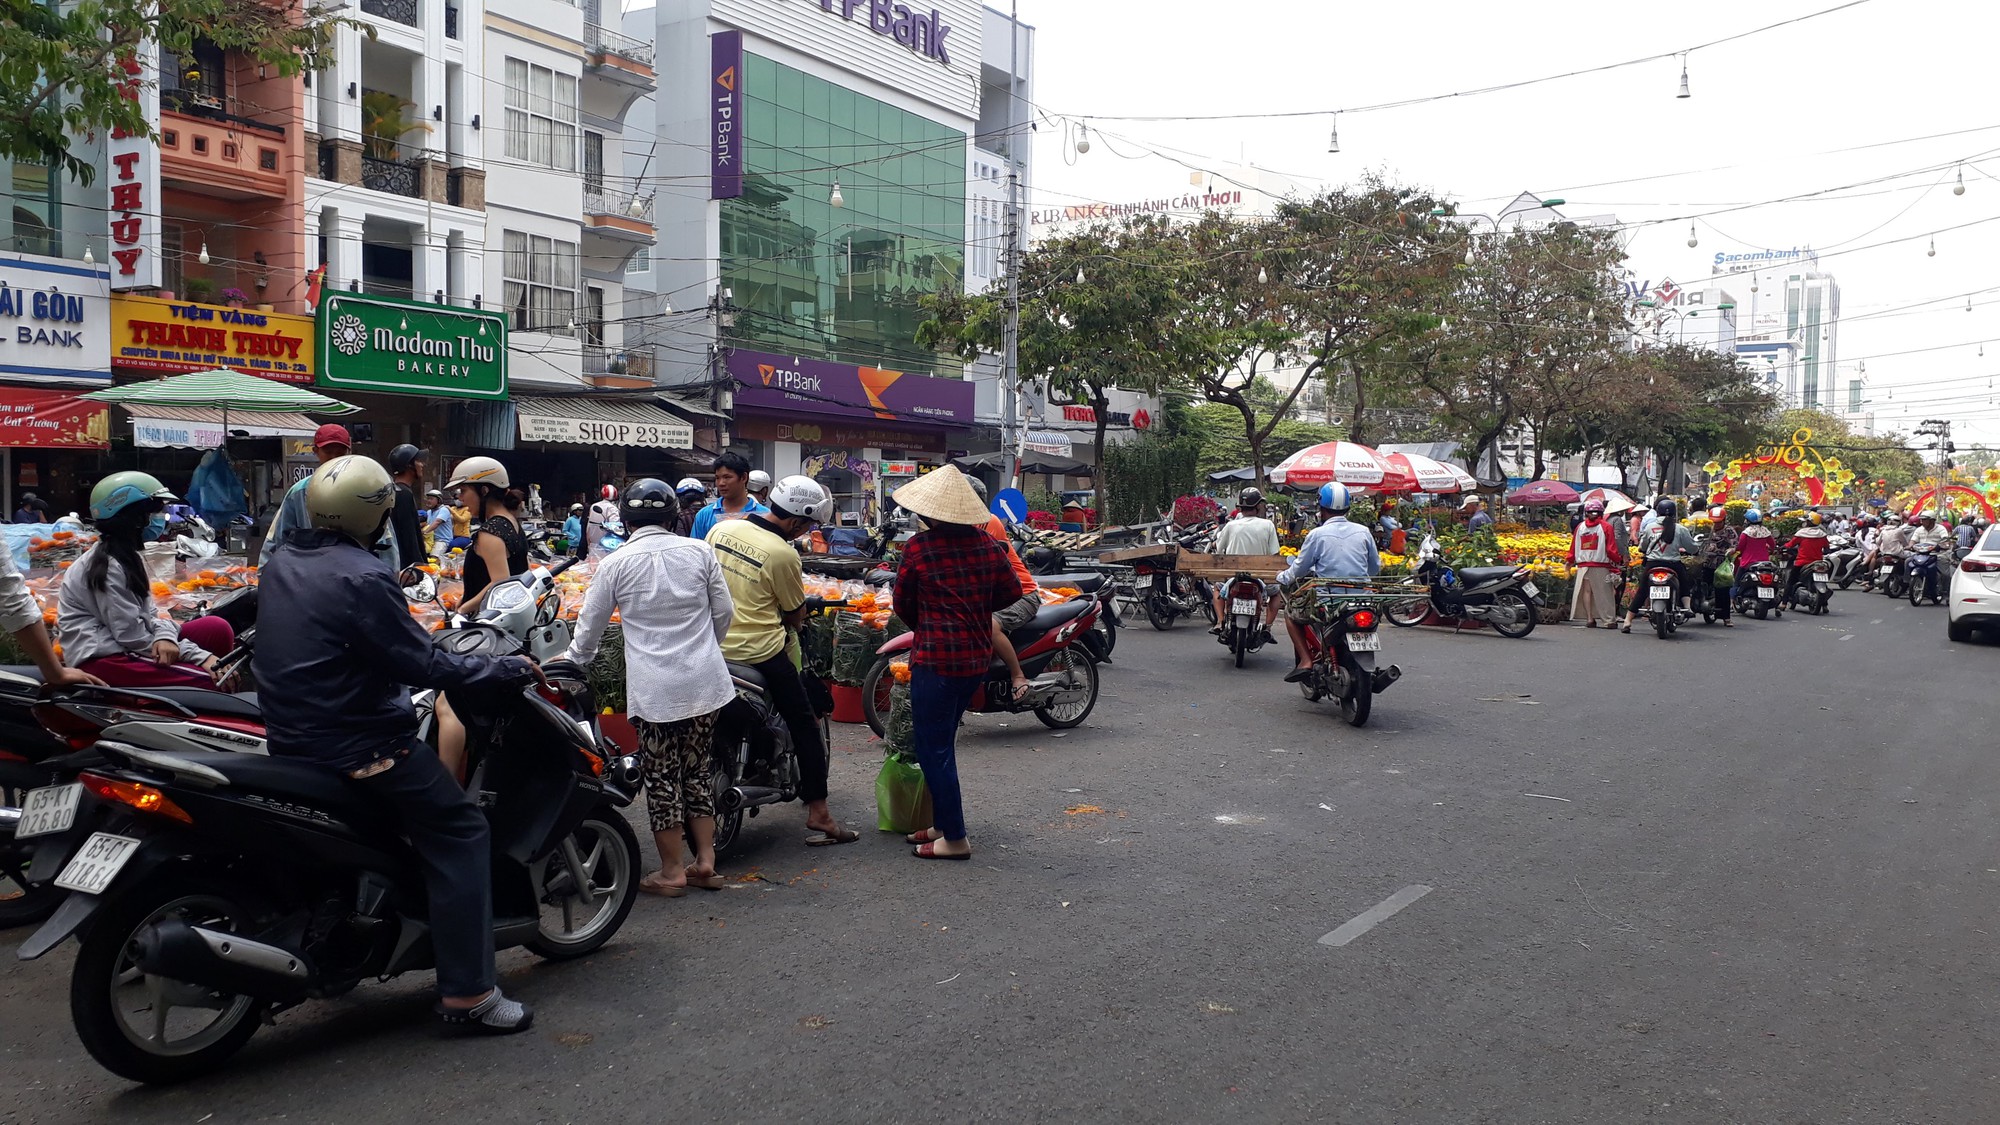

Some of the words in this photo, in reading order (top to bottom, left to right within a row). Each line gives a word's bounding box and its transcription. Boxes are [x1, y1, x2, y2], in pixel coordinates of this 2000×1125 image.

[718, 92, 732, 167] TPBank
[111, 152, 142, 275] THÚY
[1124, 199, 1168, 215] NHÁNH
[1172, 193, 1199, 209] CẦN
[1202, 191, 1230, 206] THƠ
[1233, 191, 1241, 204] II
[1714, 246, 1800, 265] Sacombank
[170, 305, 214, 322] TIỆM
[220, 309, 267, 327] VÀNG
[17, 326, 83, 348] BANK
[128, 319, 227, 352] THANH
[232, 330, 303, 360] THÚY
[374, 327, 453, 358] Madam
[456, 335, 494, 362] Thu
[121, 346, 158, 359] CHUYÊN
[160, 350, 181, 361] MUA
[183, 352, 201, 363] BÁN
[250, 357, 271, 370] VÀNG
[397, 359, 470, 377] BAKERY
[776, 369, 822, 392] TPBank
[163, 427, 189, 445] VÀNG
[579, 422, 630, 444] SHOP
[636, 425, 659, 444] 23
[1339, 461, 1375, 469] VEDAN
[1417, 469, 1446, 477] VEDAN
[315, 512, 342, 520] PILOT
[32, 786, 73, 811] 65-K1
[579, 781, 599, 793] HONDA
[20, 808, 72, 835] 026.80
[85, 837, 130, 863] 65-C1
[62, 861, 115, 890] 018.64
